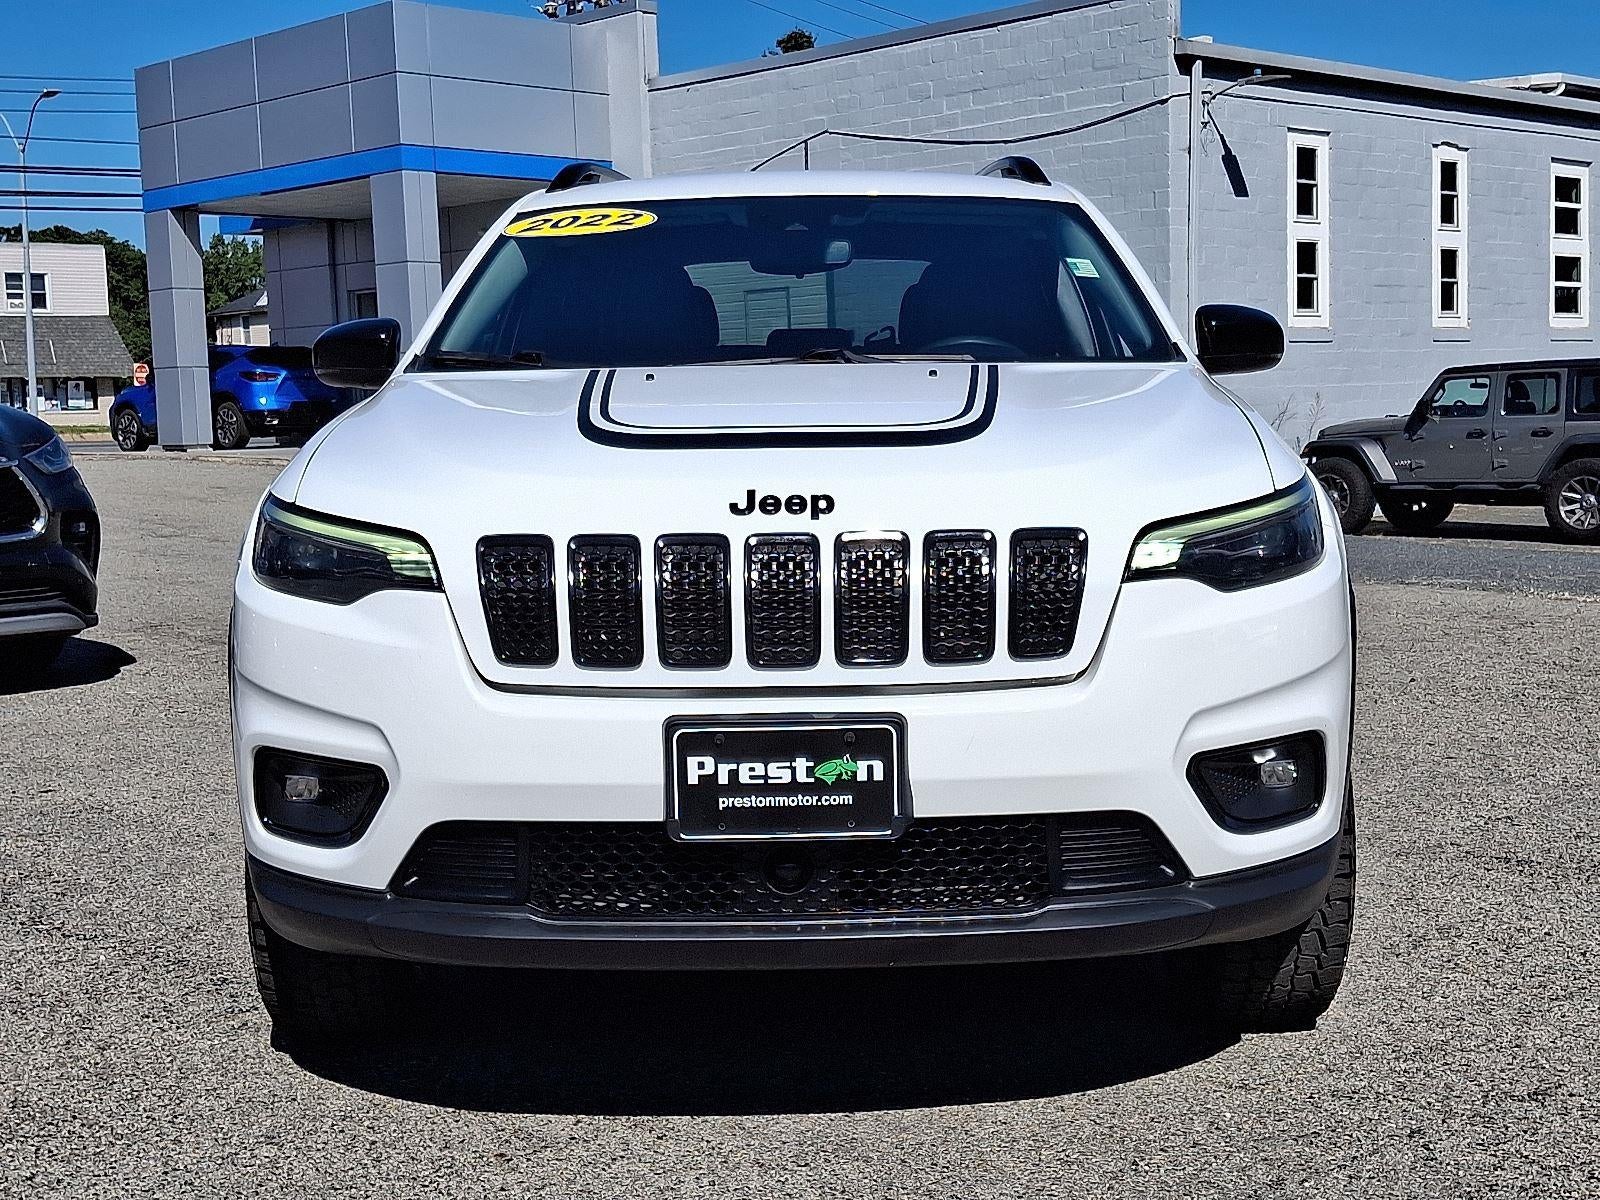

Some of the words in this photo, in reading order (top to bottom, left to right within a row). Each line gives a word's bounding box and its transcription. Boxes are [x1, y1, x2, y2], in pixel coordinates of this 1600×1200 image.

[515, 213, 644, 234] 2022
[728, 488, 836, 521] Jeep
[718, 793, 853, 810] prestonmotor.com
